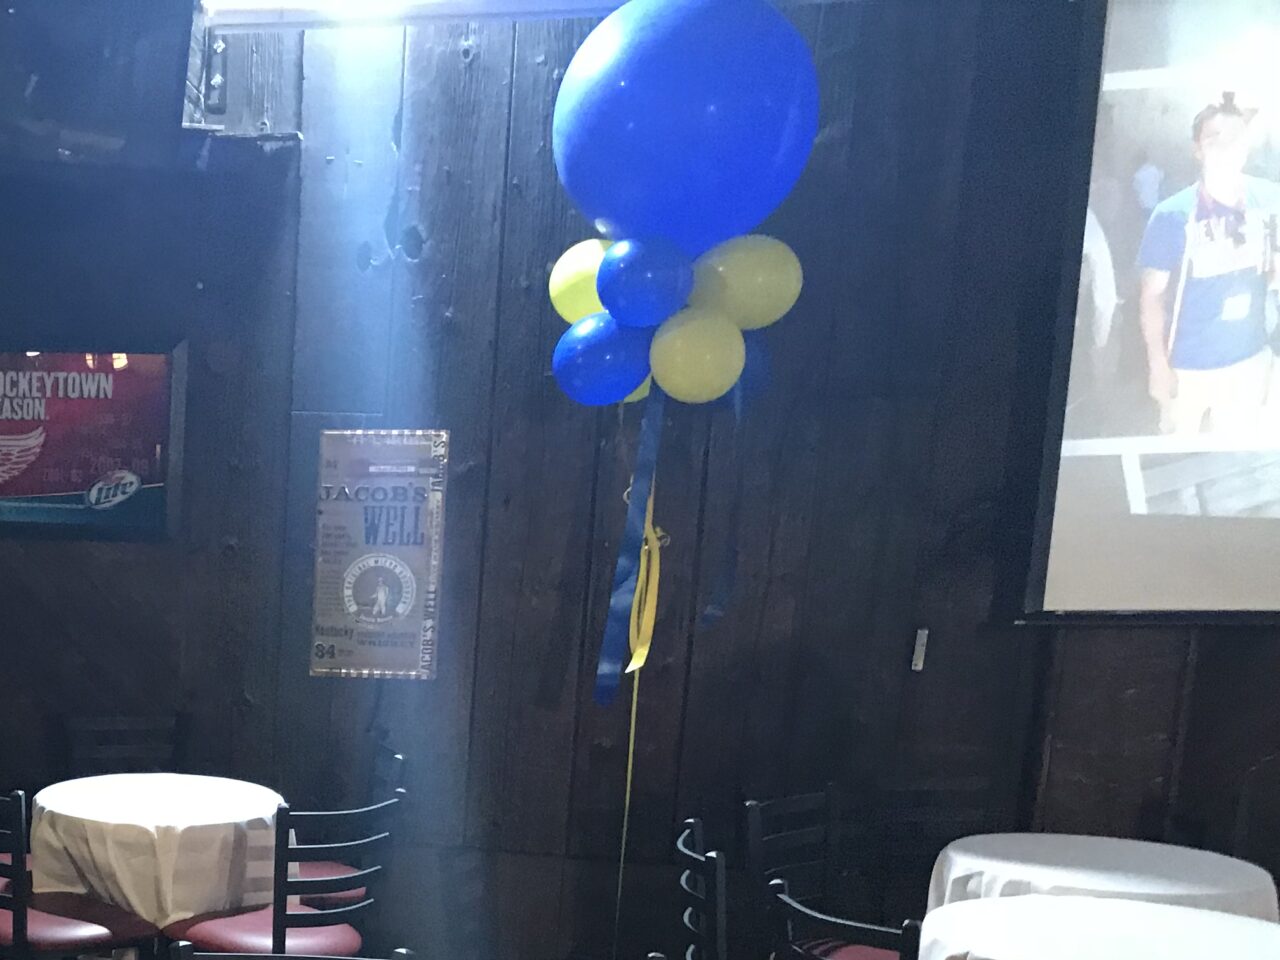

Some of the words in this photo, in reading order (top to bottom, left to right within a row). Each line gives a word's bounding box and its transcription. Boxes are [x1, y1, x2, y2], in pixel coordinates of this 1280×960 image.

[94, 478, 135, 506] Lite
[319, 481, 429, 504] JACOB'S
[363, 505, 425, 547] WELL
[423, 589, 438, 622] WELL
[314, 642, 337, 661] 84
[420, 625, 436, 674] ACOB'S
